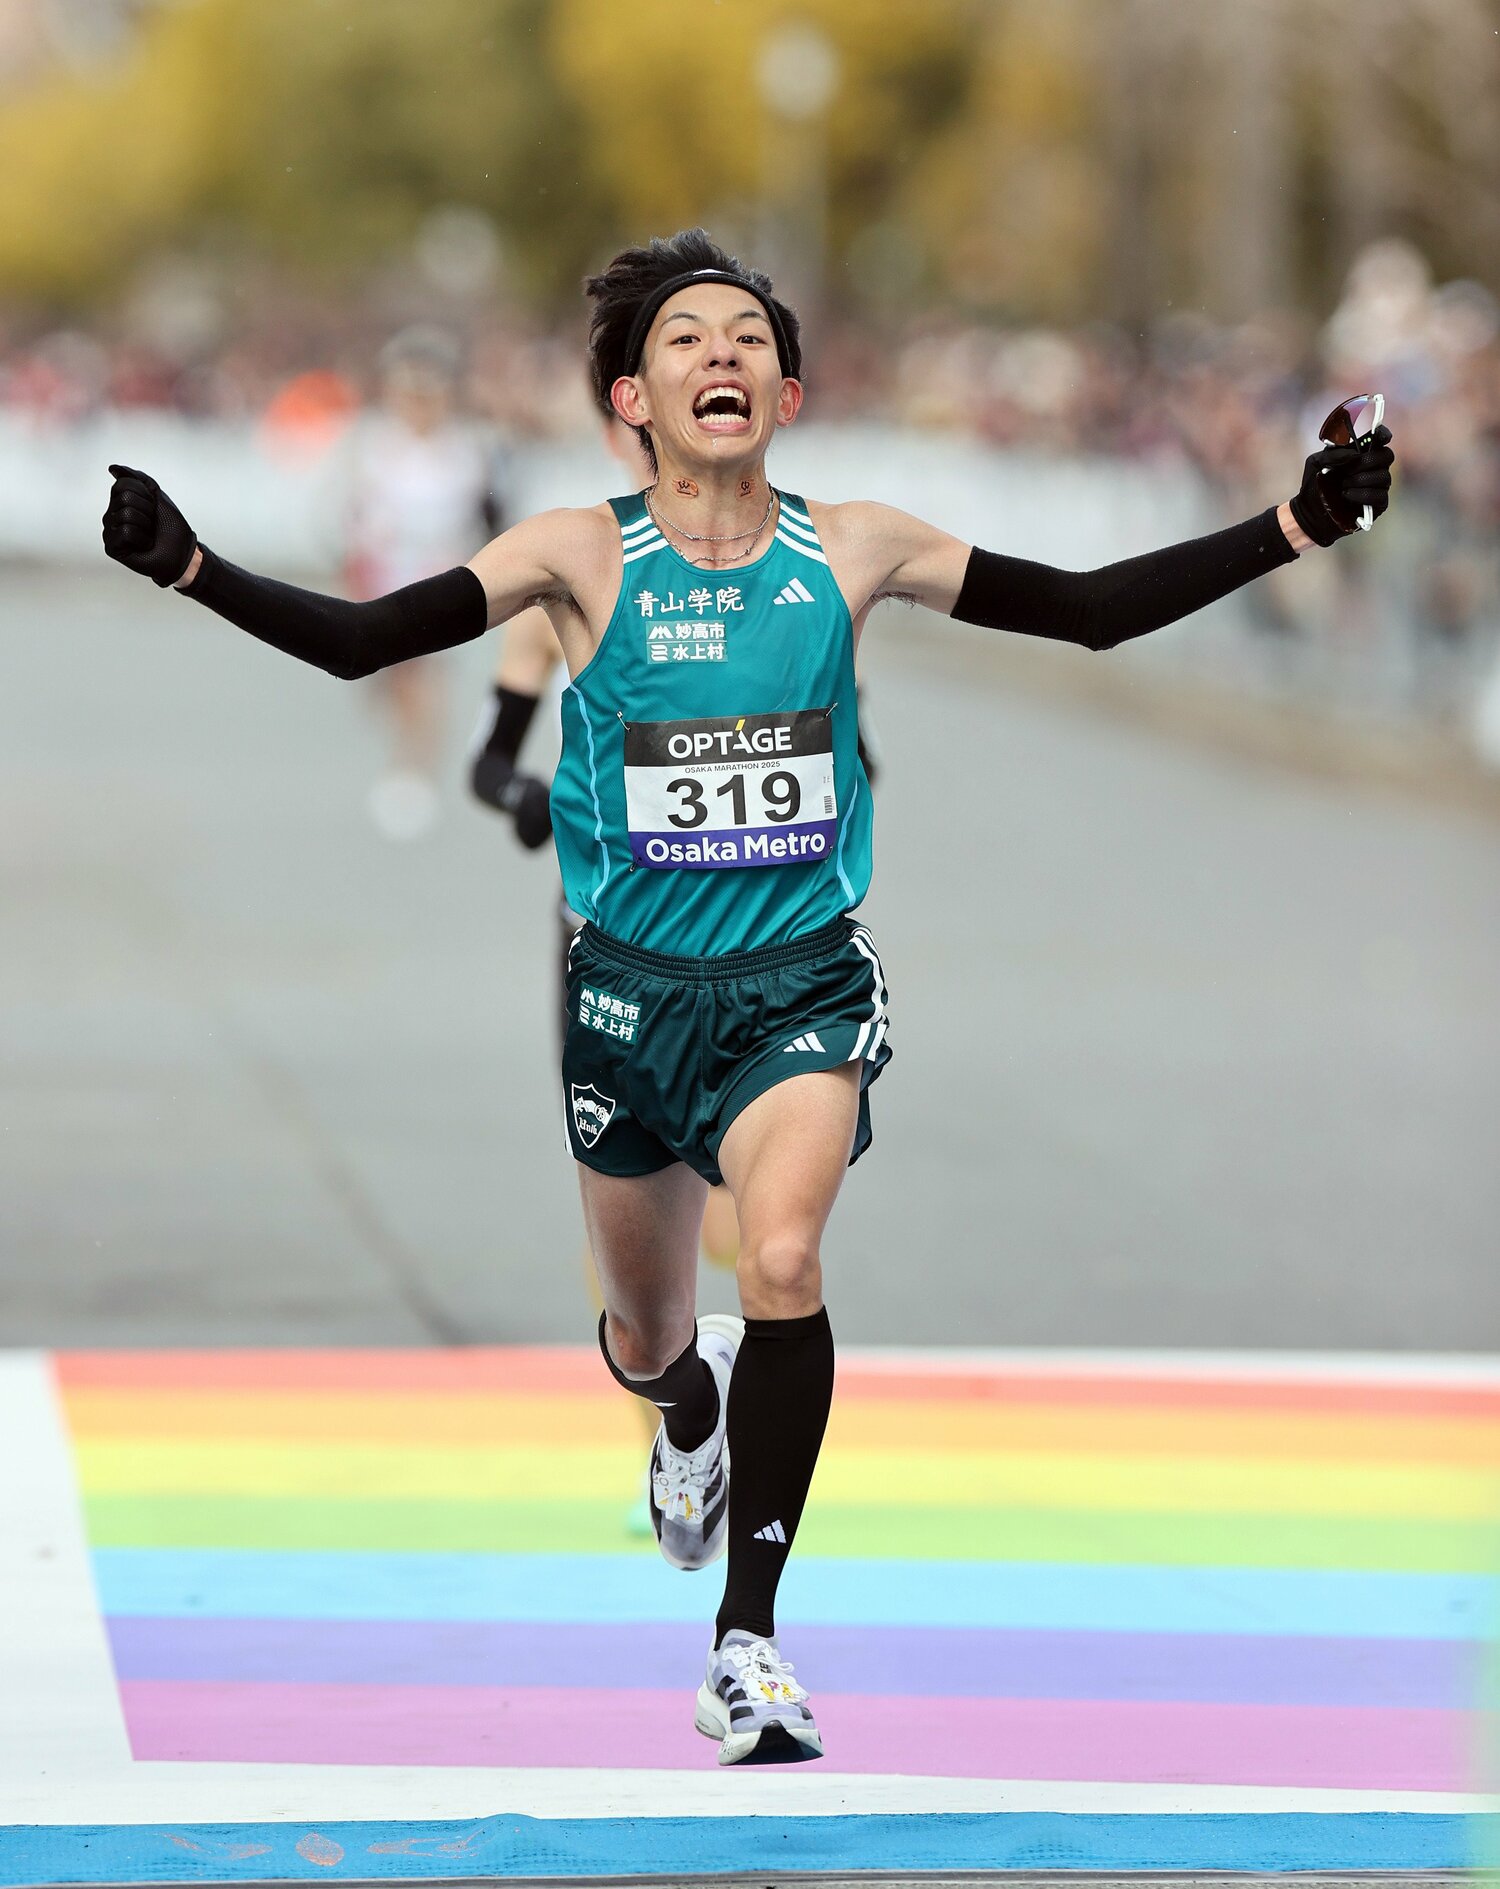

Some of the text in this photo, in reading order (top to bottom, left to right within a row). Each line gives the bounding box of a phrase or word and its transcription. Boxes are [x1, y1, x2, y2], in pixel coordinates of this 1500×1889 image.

[633, 586, 745, 618] 青山学院
[675, 622, 725, 640] 妙高市
[672, 643, 724, 661] 水上村
[667, 719, 793, 759] OPTAGE
[684, 761, 781, 774] OSAKA MARATHON 2025
[666, 771, 801, 829] 319
[645, 832, 826, 863] Osaka Metro
[597, 993, 641, 1022] 妙高市
[592, 1014, 635, 1041] 水上村
